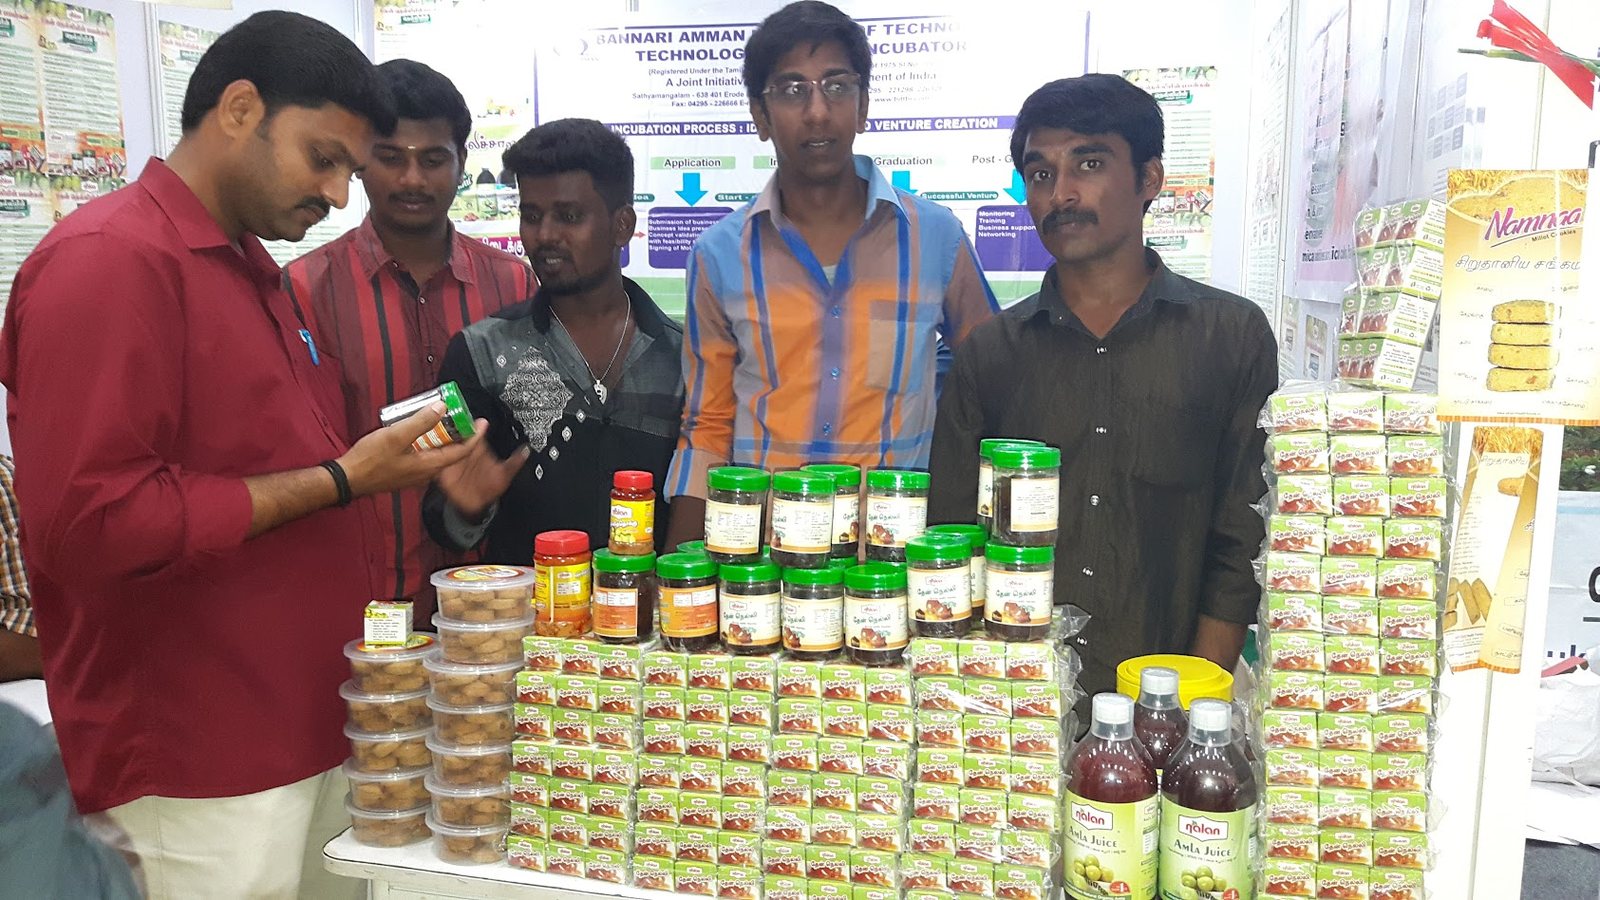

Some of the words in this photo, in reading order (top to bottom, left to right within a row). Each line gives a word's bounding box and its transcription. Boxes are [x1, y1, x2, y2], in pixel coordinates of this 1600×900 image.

[596, 32, 673, 45] BANNARI
[679, 30, 745, 43] AMMAN
[864, 24, 877, 36] F
[636, 48, 746, 62] TECHNOLOG
[868, 41, 968, 55] NCUBATOR
[648, 68, 688, 76] (Registered
[666, 78, 673, 86] A
[676, 78, 702, 87] Joint
[706, 76, 744, 86] Initiativ
[895, 72, 906, 80] of
[611, 124, 680, 134] INCUBATION
[684, 123, 736, 134] PROCESS
[746, 123, 758, 132] ID
[874, 119, 932, 131] VENTURE
[934, 118, 998, 130] CREATION
[664, 158, 721, 168] Application
[874, 157, 932, 166] Graduation
[972, 155, 995, 164] Post
[1484, 207, 1582, 240] Namnaa
[1550, 230, 1576, 238] Cokies
[1076, 810, 1104, 825] nalan
[1186, 823, 1220, 835] nalan
